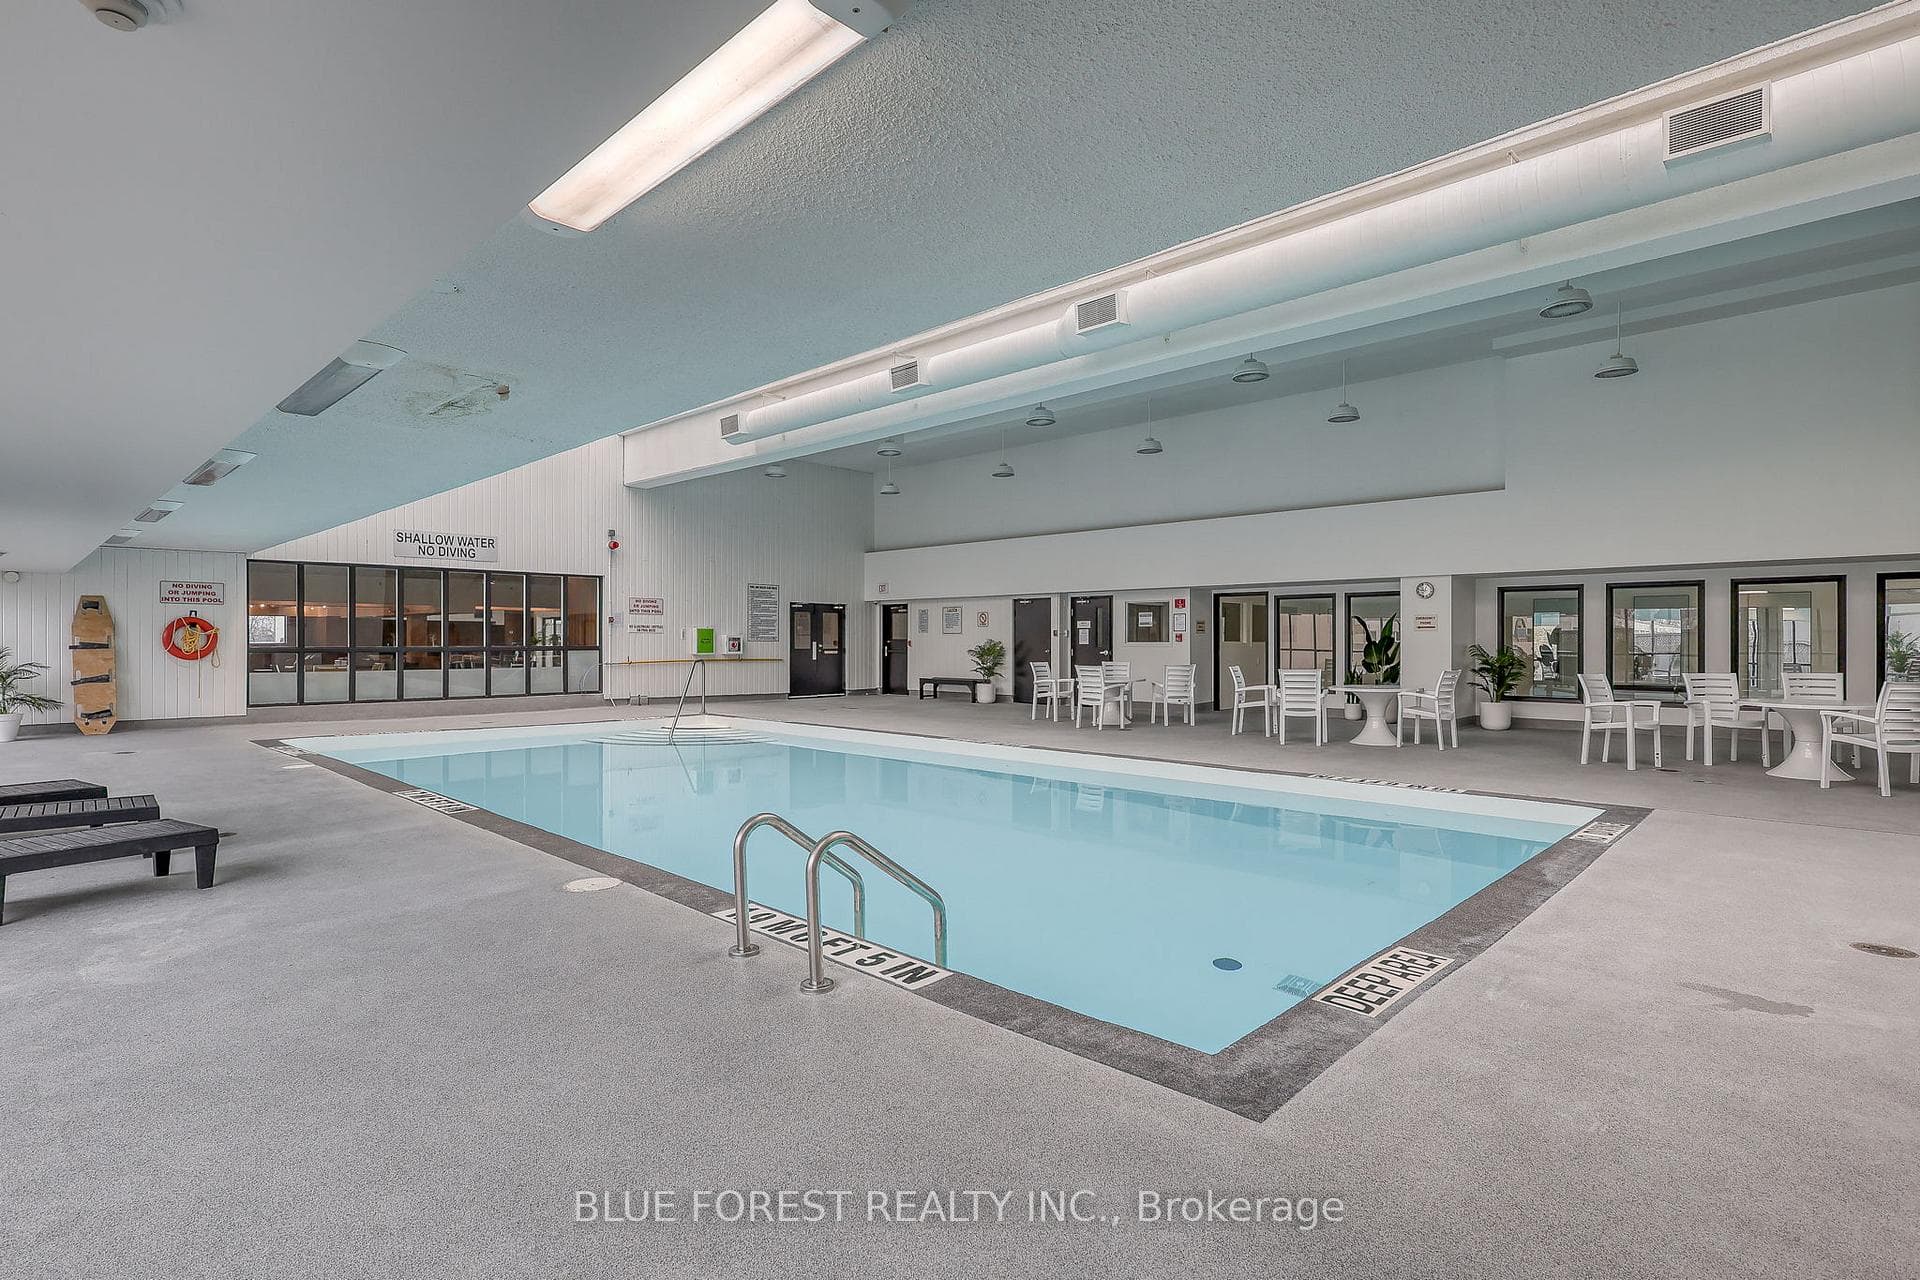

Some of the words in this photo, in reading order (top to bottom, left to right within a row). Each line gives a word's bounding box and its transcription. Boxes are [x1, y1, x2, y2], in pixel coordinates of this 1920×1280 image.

[396, 532, 455, 546] SHALLOW
[457, 536, 495, 549] WATER
[418, 545, 435, 556] NO
[438, 546, 476, 559] DIVING
[760, 919, 808, 935] M
[855, 951, 898, 968] 5
[879, 961, 939, 985] IN
[1319, 972, 1404, 1015] DEEP
[1371, 950, 1448, 983] AREA
